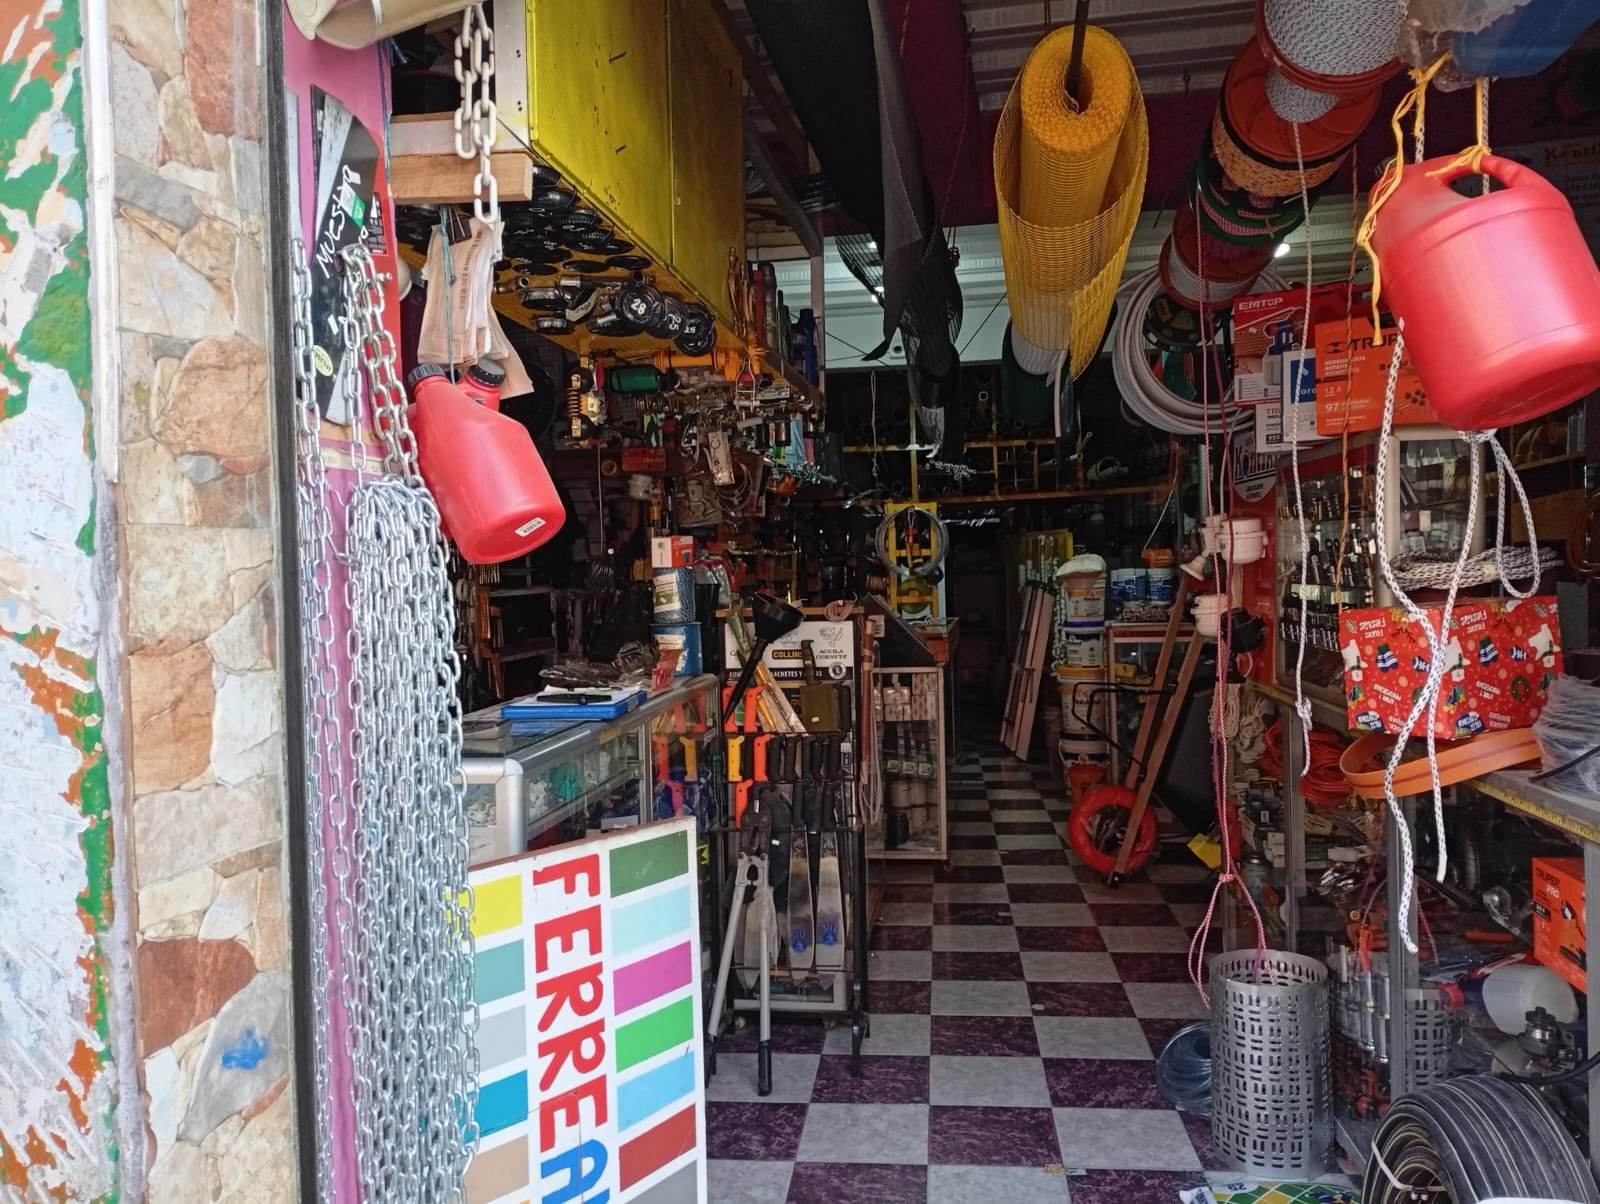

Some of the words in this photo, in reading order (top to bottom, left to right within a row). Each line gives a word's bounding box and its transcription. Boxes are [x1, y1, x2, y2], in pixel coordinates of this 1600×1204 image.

[630, 298, 647, 315] 28
[1239, 297, 1284, 310] EMTOP
[1349, 333, 1400, 351] TRUP
[1326, 402, 1339, 413] 97
[772, 651, 803, 659] COLLIN
[1546, 884, 1560, 898] PRO
[532, 853, 610, 1204] FERREA
